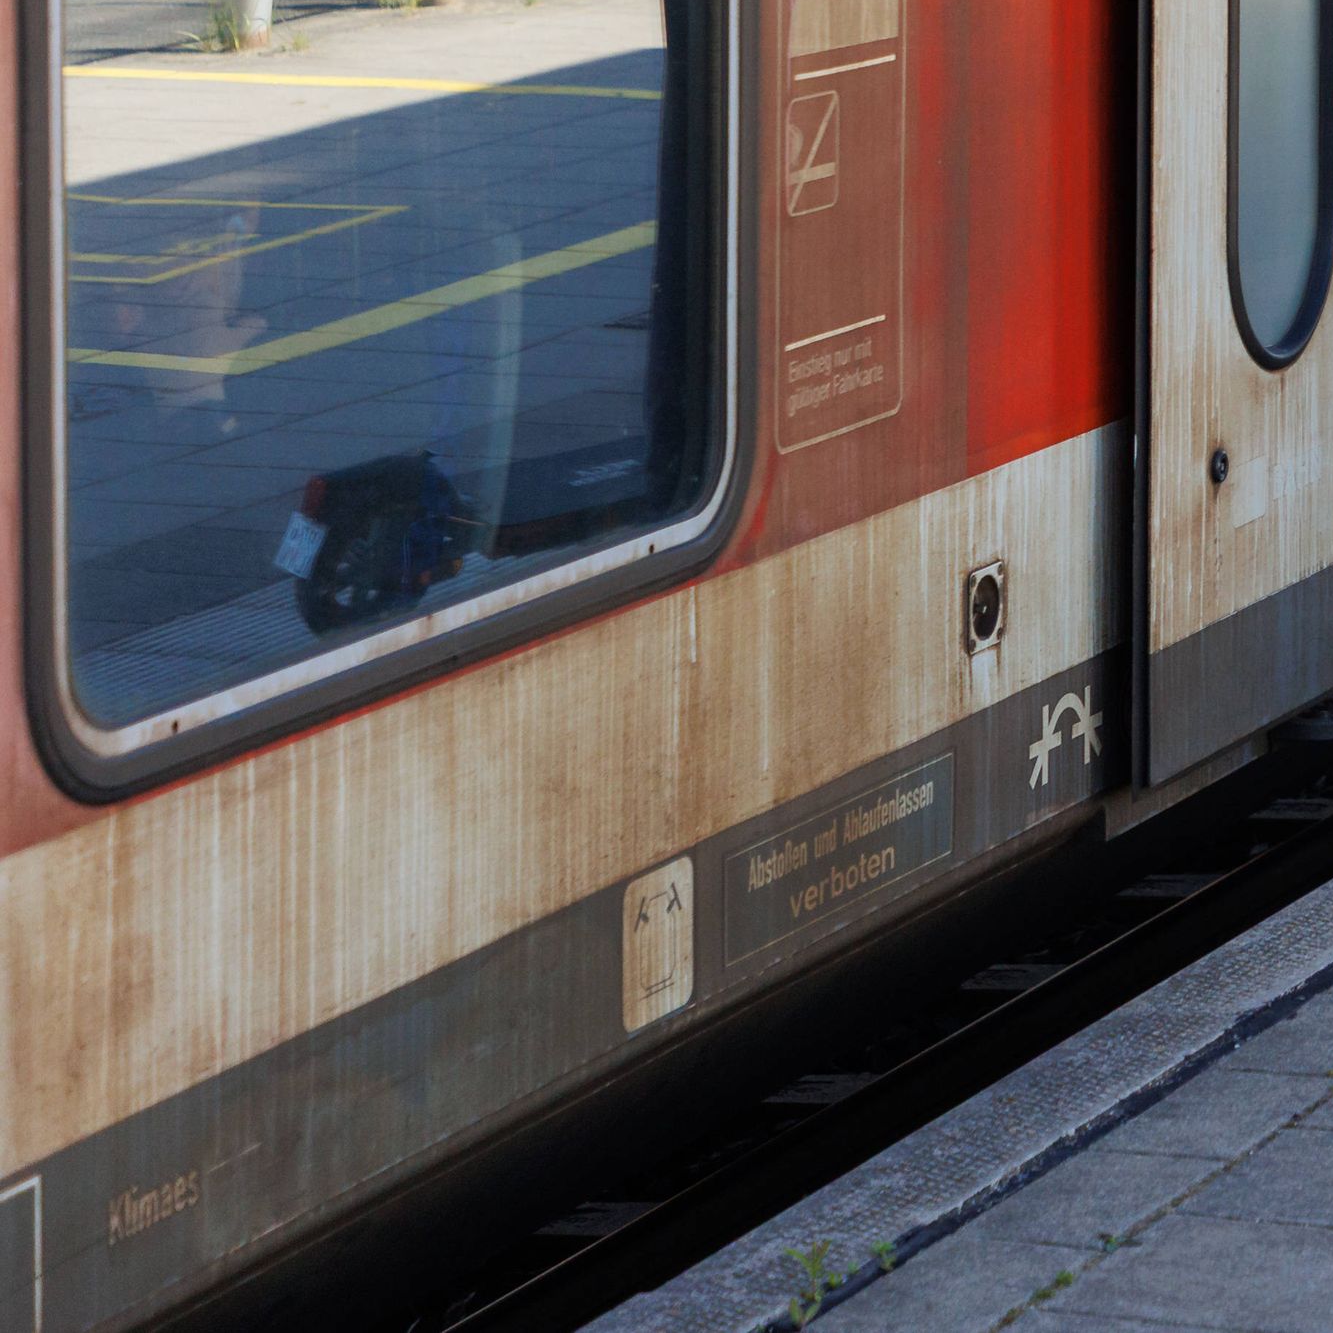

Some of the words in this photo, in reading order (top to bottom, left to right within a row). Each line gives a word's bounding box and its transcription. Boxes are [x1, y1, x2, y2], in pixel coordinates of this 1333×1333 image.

[786, 381, 831, 418] gültiger
[832, 364, 884, 398] Fahrkarte
[788, 354, 833, 383] Einstieg
[834, 346, 852, 367] nur
[854, 336, 872, 361] mit
[747, 839, 808, 893] Abstoßen
[814, 818, 838, 860] und
[843, 780, 935, 846] Ablaufenlassen
[790, 845, 896, 918] verboten
